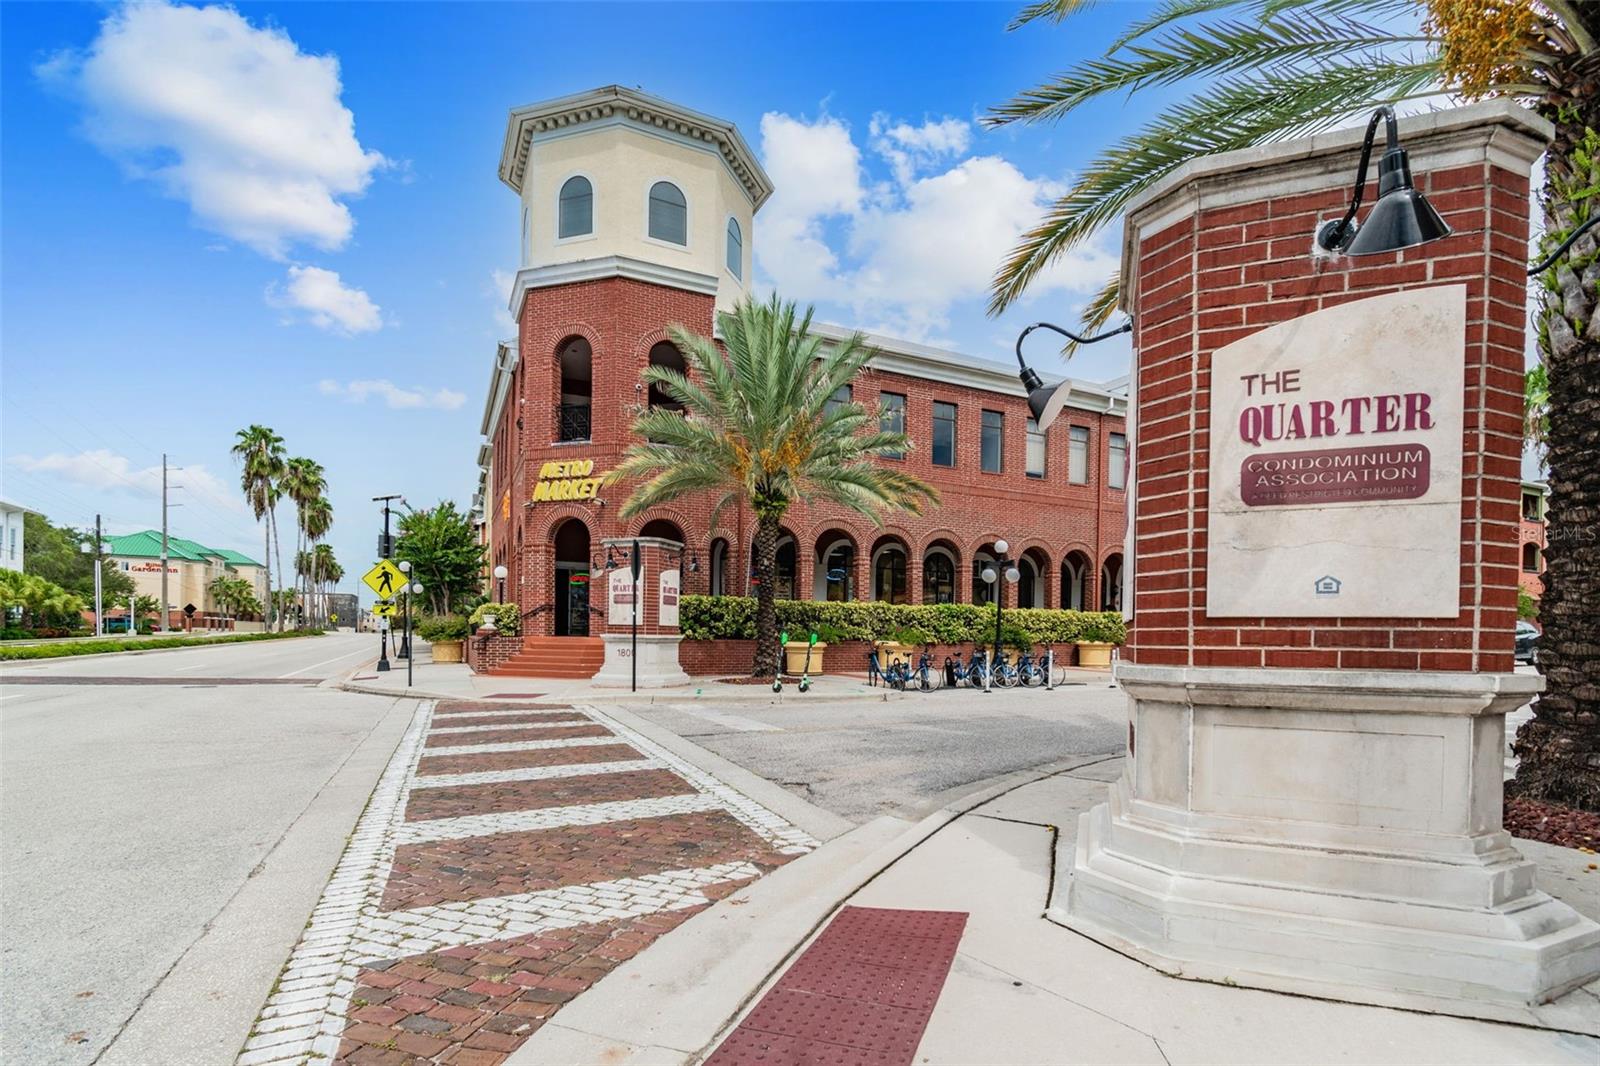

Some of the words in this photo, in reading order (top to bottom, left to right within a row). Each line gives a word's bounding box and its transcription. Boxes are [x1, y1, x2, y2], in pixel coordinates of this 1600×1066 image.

[1240, 369, 1301, 396] THE
[1239, 393, 1436, 447] QUARTER
[539, 459, 594, 479] METRO
[1248, 450, 1423, 473] CONDOMINIUM
[1256, 467, 1417, 487] ASSOCIATION
[532, 477, 604, 502] MARKET
